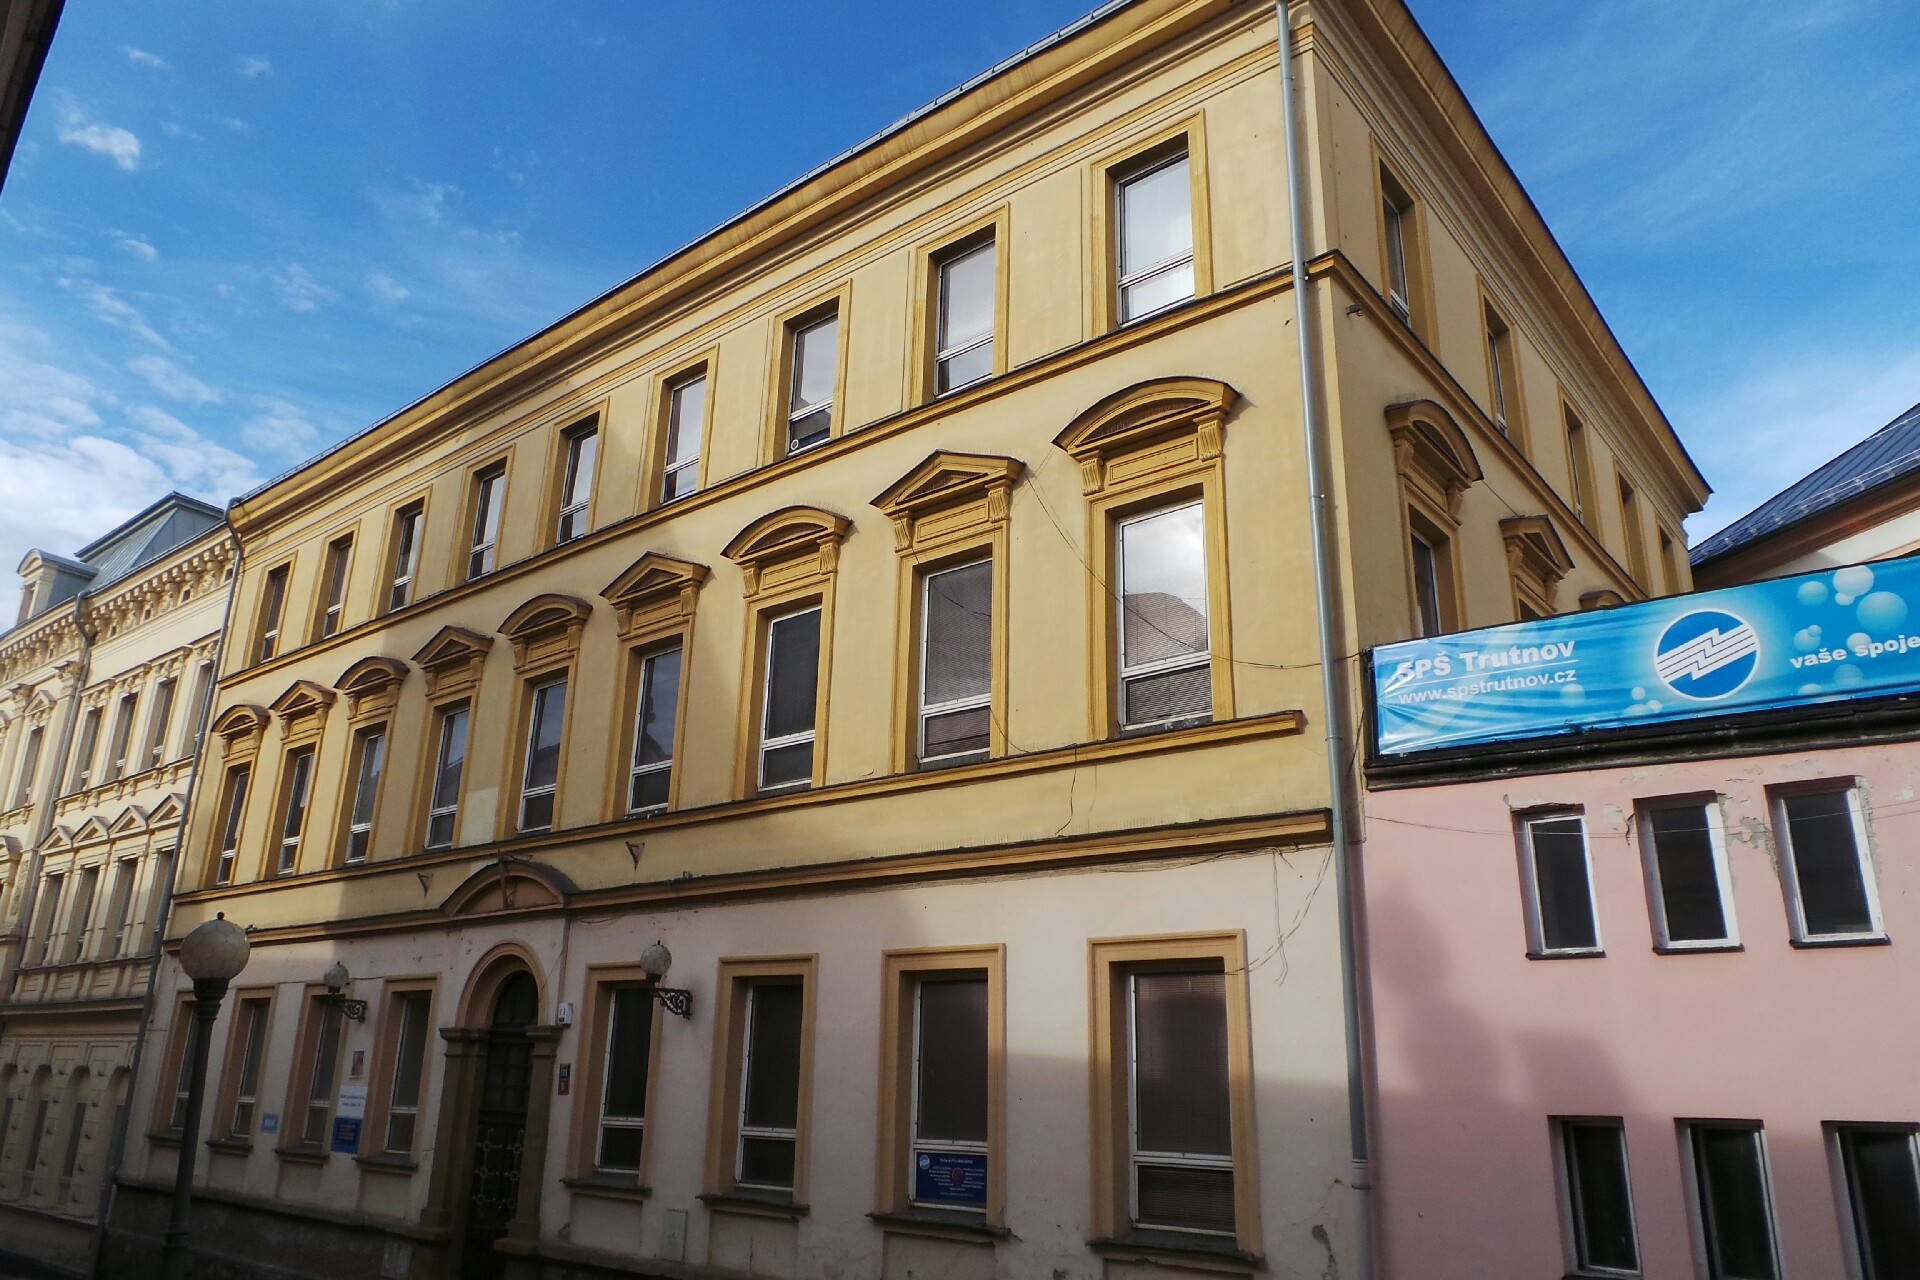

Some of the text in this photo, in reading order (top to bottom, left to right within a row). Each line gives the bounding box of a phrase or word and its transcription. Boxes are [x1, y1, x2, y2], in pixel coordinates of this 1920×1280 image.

[1397, 640, 1576, 681] SPŠ Trutnov
[1789, 635, 1920, 669] vaše spoje
[1398, 670, 1577, 705] www.spstrutnov.cz
